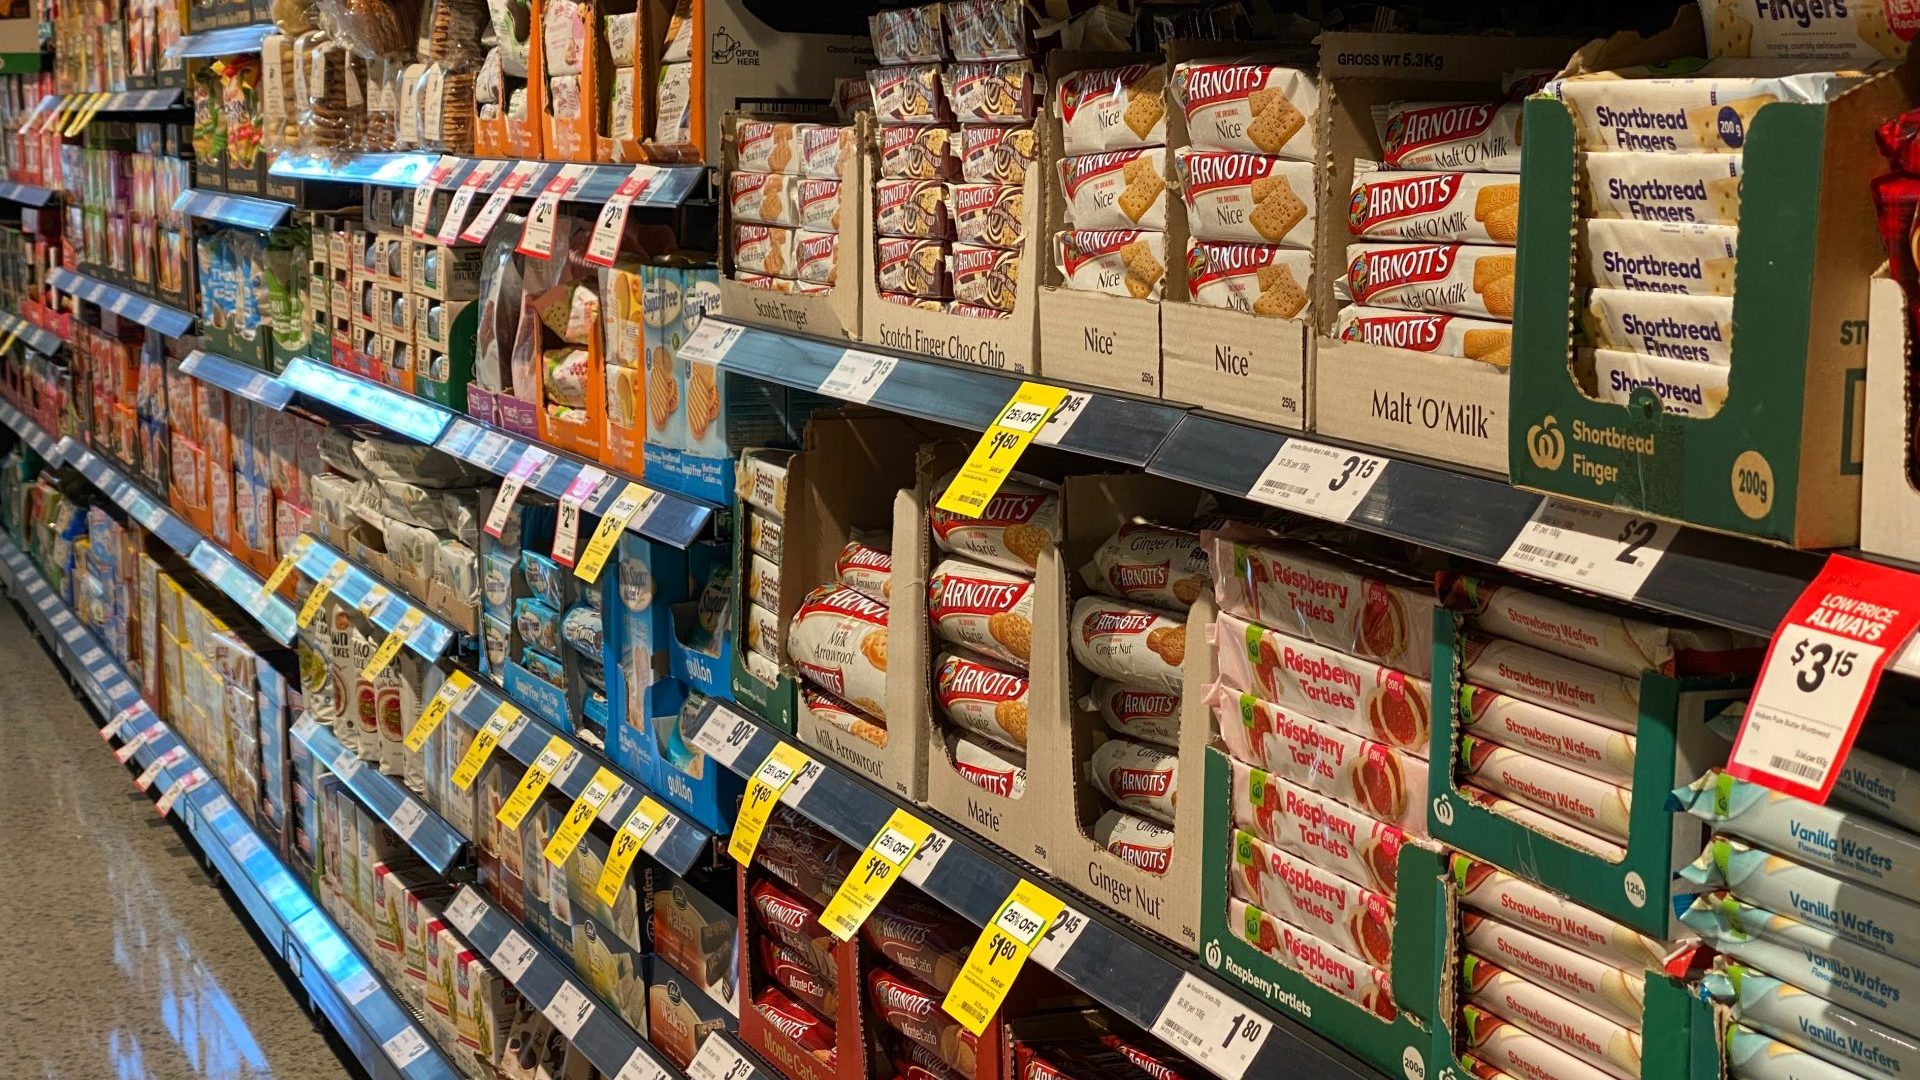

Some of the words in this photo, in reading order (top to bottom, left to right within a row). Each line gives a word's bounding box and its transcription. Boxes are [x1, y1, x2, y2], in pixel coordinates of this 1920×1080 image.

[1758, 0, 1848, 28] Fingers
[735, 49, 759, 57] OPEN
[737, 58, 760, 66] HERE
[1338, 53, 1380, 66] GROSS
[1382, 55, 1399, 66] WT
[1402, 53, 1444, 70] 5.3Kg
[1099, 109, 1120, 128] Nice
[1216, 121, 1241, 140] Nice
[1597, 105, 1687, 130] Shortbread
[1616, 128, 1677, 152] Fingers
[1093, 190, 1115, 210] Nice
[1609, 178, 1707, 201] Shortbread
[1217, 207, 1244, 226] Nice
[1629, 199, 1695, 221] Fingers
[1603, 251, 1702, 279] Shortbread
[1097, 272, 1120, 289] Nice
[1623, 274, 1689, 295] Fingers
[754, 298, 781, 321] Scotch
[781, 302, 807, 329] Finger
[1226, 294, 1250, 312] Nice
[1084, 326, 1114, 355] Nice
[1622, 314, 1722, 342] Shortbread
[880, 324, 912, 350] Scotch
[915, 332, 946, 356] Finger
[948, 335, 976, 360] Choc
[979, 341, 1005, 368] Chip
[1215, 344, 1249, 376] Nice
[1644, 336, 1710, 362] Fingers
[1142, 372, 1153, 386] 250g
[1020, 411, 1041, 425] OFF
[1282, 397, 1296, 411] 250g
[1573, 419, 1654, 455] Shortbread
[1573, 454, 1618, 486] Finger
[1738, 468, 1768, 504] 200g
[966, 541, 997, 557] Marie
[1131, 534, 1169, 553] Ginger
[1616, 518, 1658, 565] $2
[943, 579, 1019, 608] ARNOTT'S
[1272, 561, 1348, 608] Raspberry
[1821, 593, 1855, 612] LOW
[1854, 598, 1900, 625] PRICE
[959, 626, 984, 645] Marie
[1508, 609, 1560, 636] Strawberry
[1560, 624, 1598, 647] Wafers
[1805, 607, 1886, 641] ALWAYS
[814, 644, 855, 665] Arrowroot
[828, 632, 847, 649] Milk
[1096, 644, 1117, 658] Ginger
[1118, 644, 1133, 655] Nut
[952, 665, 1023, 697] ARNOTT'S
[1284, 647, 1361, 697] Raspberry
[1499, 663, 1554, 695] Strawberry
[1556, 680, 1595, 705] Wafers
[1299, 679, 1355, 710] Tartlets
[965, 713, 992, 733] Marie
[1276, 711, 1345, 766] Raspberry
[1505, 717, 1561, 751] Strawberry
[1562, 735, 1601, 761] Wafers
[815, 726, 836, 752] Milk
[836, 739, 883, 780] Arrowroot
[775, 769, 790, 782] OFF
[1122, 773, 1167, 792] ARNOTT'S
[1853, 775, 1896, 802] Wafers
[1502, 771, 1557, 805] Strawberry
[1558, 792, 1595, 818] Wafers
[967, 797, 1001, 832] Marie
[1286, 790, 1357, 844] Raspberry
[1136, 820, 1174, 838] Ginger
[1299, 824, 1349, 859] Tartlets
[892, 842, 909, 857] OFF
[1791, 820, 1838, 851] Vanilla
[1839, 842, 1893, 871] Wafers
[1088, 862, 1132, 905] Ginger
[1135, 884, 1161, 920] Nut
[1271, 852, 1346, 911] Raspberry
[1626, 880, 1646, 900] 125g
[1293, 895, 1334, 926] artlets
[1501, 893, 1562, 928] Strawberry
[1563, 917, 1607, 945] Wafers
[1790, 890, 1839, 923] Vanilla
[1840, 912, 1894, 944] Wafers
[1017, 917, 1038, 936] OFF
[1182, 924, 1196, 941] 250g
[1284, 928, 1355, 991] Raspberry
[1497, 937, 1556, 977] Strawberry
[1555, 964, 1596, 993] Wafers
[790, 976, 809, 992] Monte
[809, 983, 823, 998] Carlo
[1226, 955, 1273, 1000] Raspberry
[1273, 982, 1312, 1019] Tartlets
[1804, 949, 1850, 980] Vanilla
[1851, 967, 1900, 1002] Wafers
[902, 1023, 919, 1040] Monte
[919, 1028, 936, 1044] Carlo
[1506, 995, 1562, 1035] Strawberry
[1563, 1023, 1601, 1055] Wafers
[764, 1029, 793, 1062] Monte
[1799, 1015, 1846, 1049] Vanilla
[1847, 1038, 1900, 1072] Wafers
[1404, 1059, 1425, 1079] 200g
